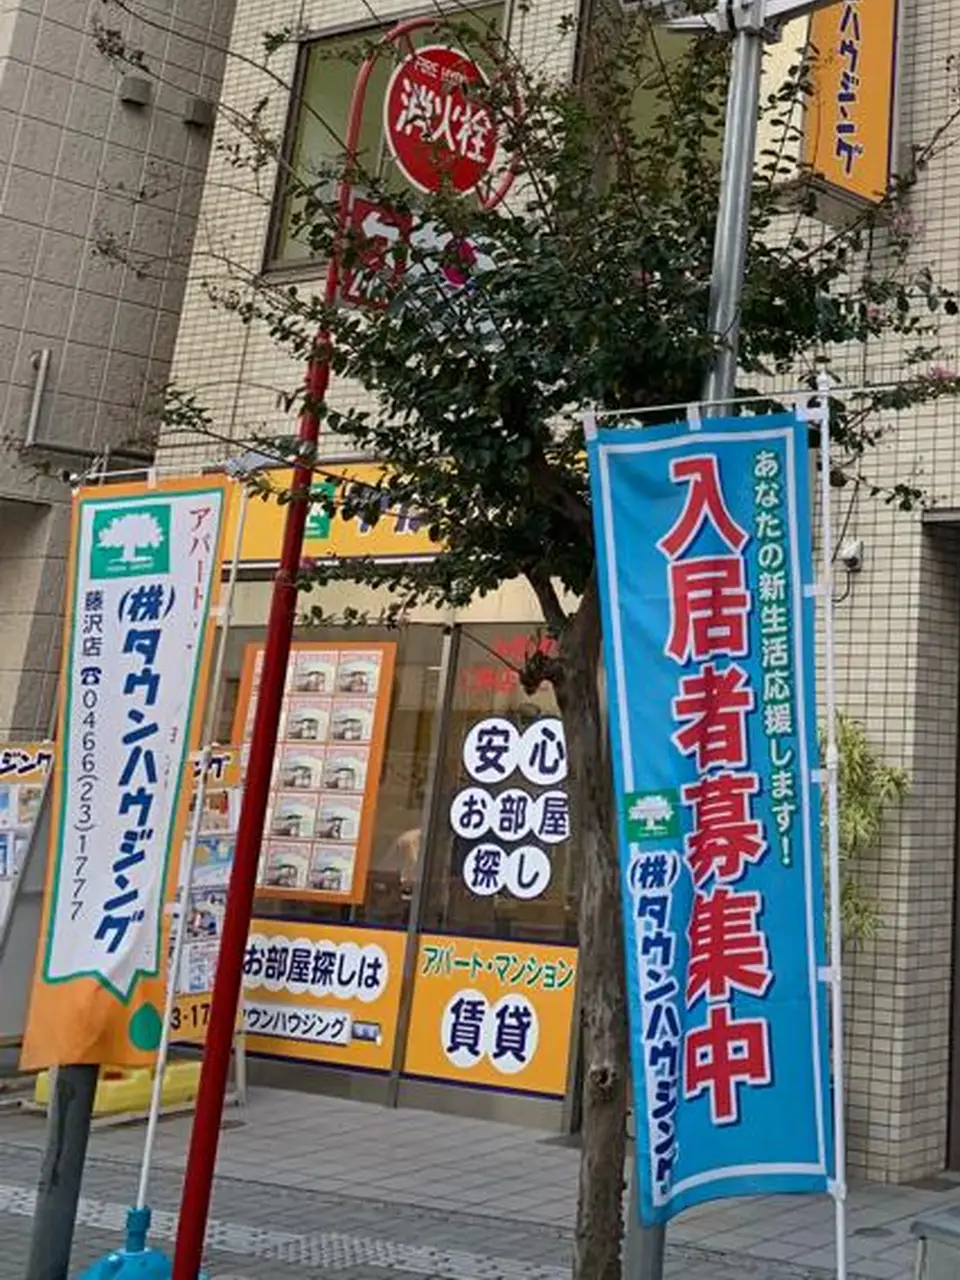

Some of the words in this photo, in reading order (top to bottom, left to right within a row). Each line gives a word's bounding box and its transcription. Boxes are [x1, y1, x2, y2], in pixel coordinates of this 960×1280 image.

[395, 77, 493, 164] 消火栓
[82, 590, 104, 658] 藤沢店
[94, 583, 177, 954] (株)タウンハウジング
[474, 725, 566, 774] 安心
[71, 688, 99, 921] 0466(23)1777
[459, 794, 569, 836] お部屋
[660, 455, 774, 1124] 入居者募集中
[471, 848, 540, 889] 探し
[244, 943, 383, 990] お部屋探しは
[422, 945, 575, 988] アパート・マンション
[242, 1005, 347, 1040] ウンハウジング
[446, 997, 533, 1062] 賃貸
